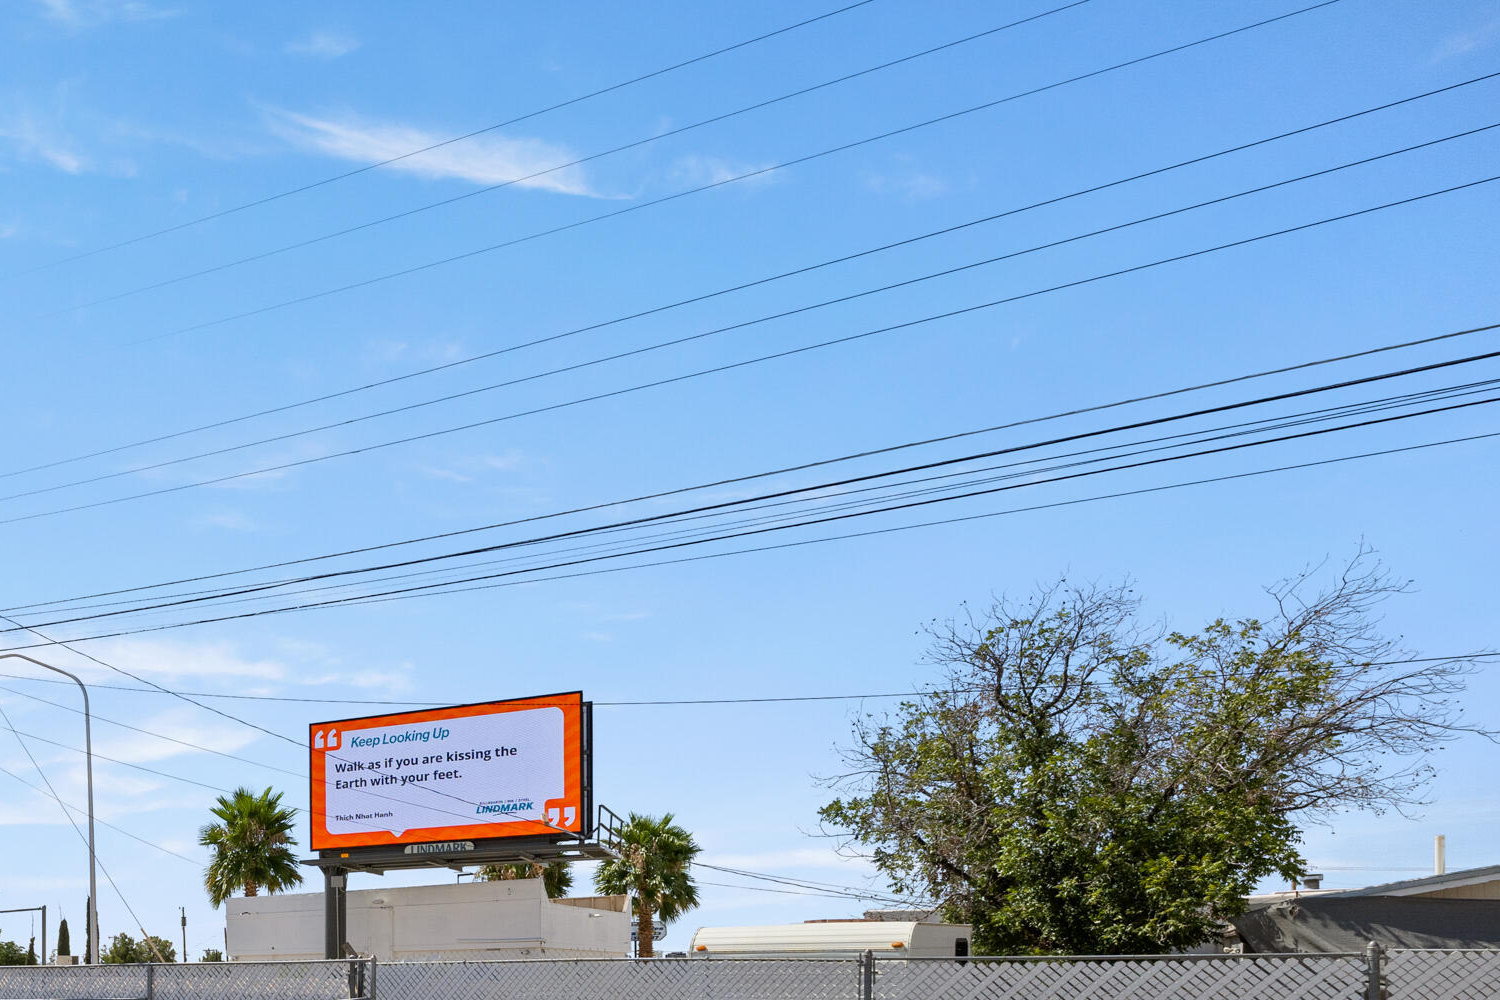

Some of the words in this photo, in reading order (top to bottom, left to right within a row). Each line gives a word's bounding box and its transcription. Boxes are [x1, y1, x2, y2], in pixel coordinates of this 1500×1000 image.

[350, 736, 380, 748] Keep
[382, 730, 430, 743] Looking
[432, 727, 450, 741] Up
[335, 761, 365, 773] Walk
[368, 760, 381, 770] as
[384, 757, 393, 768] if
[396, 757, 418, 770] you
[422, 754, 443, 765] are
[446, 749, 492, 761] kissing
[495, 746, 517, 757] the
[335, 777, 367, 789] Earth
[370, 774, 398, 787] with
[401, 772, 430, 786] your
[433, 769, 462, 780] feet.
[476, 802, 534, 814] LINDMARK
[411, 842, 467, 854] LINDMARK
